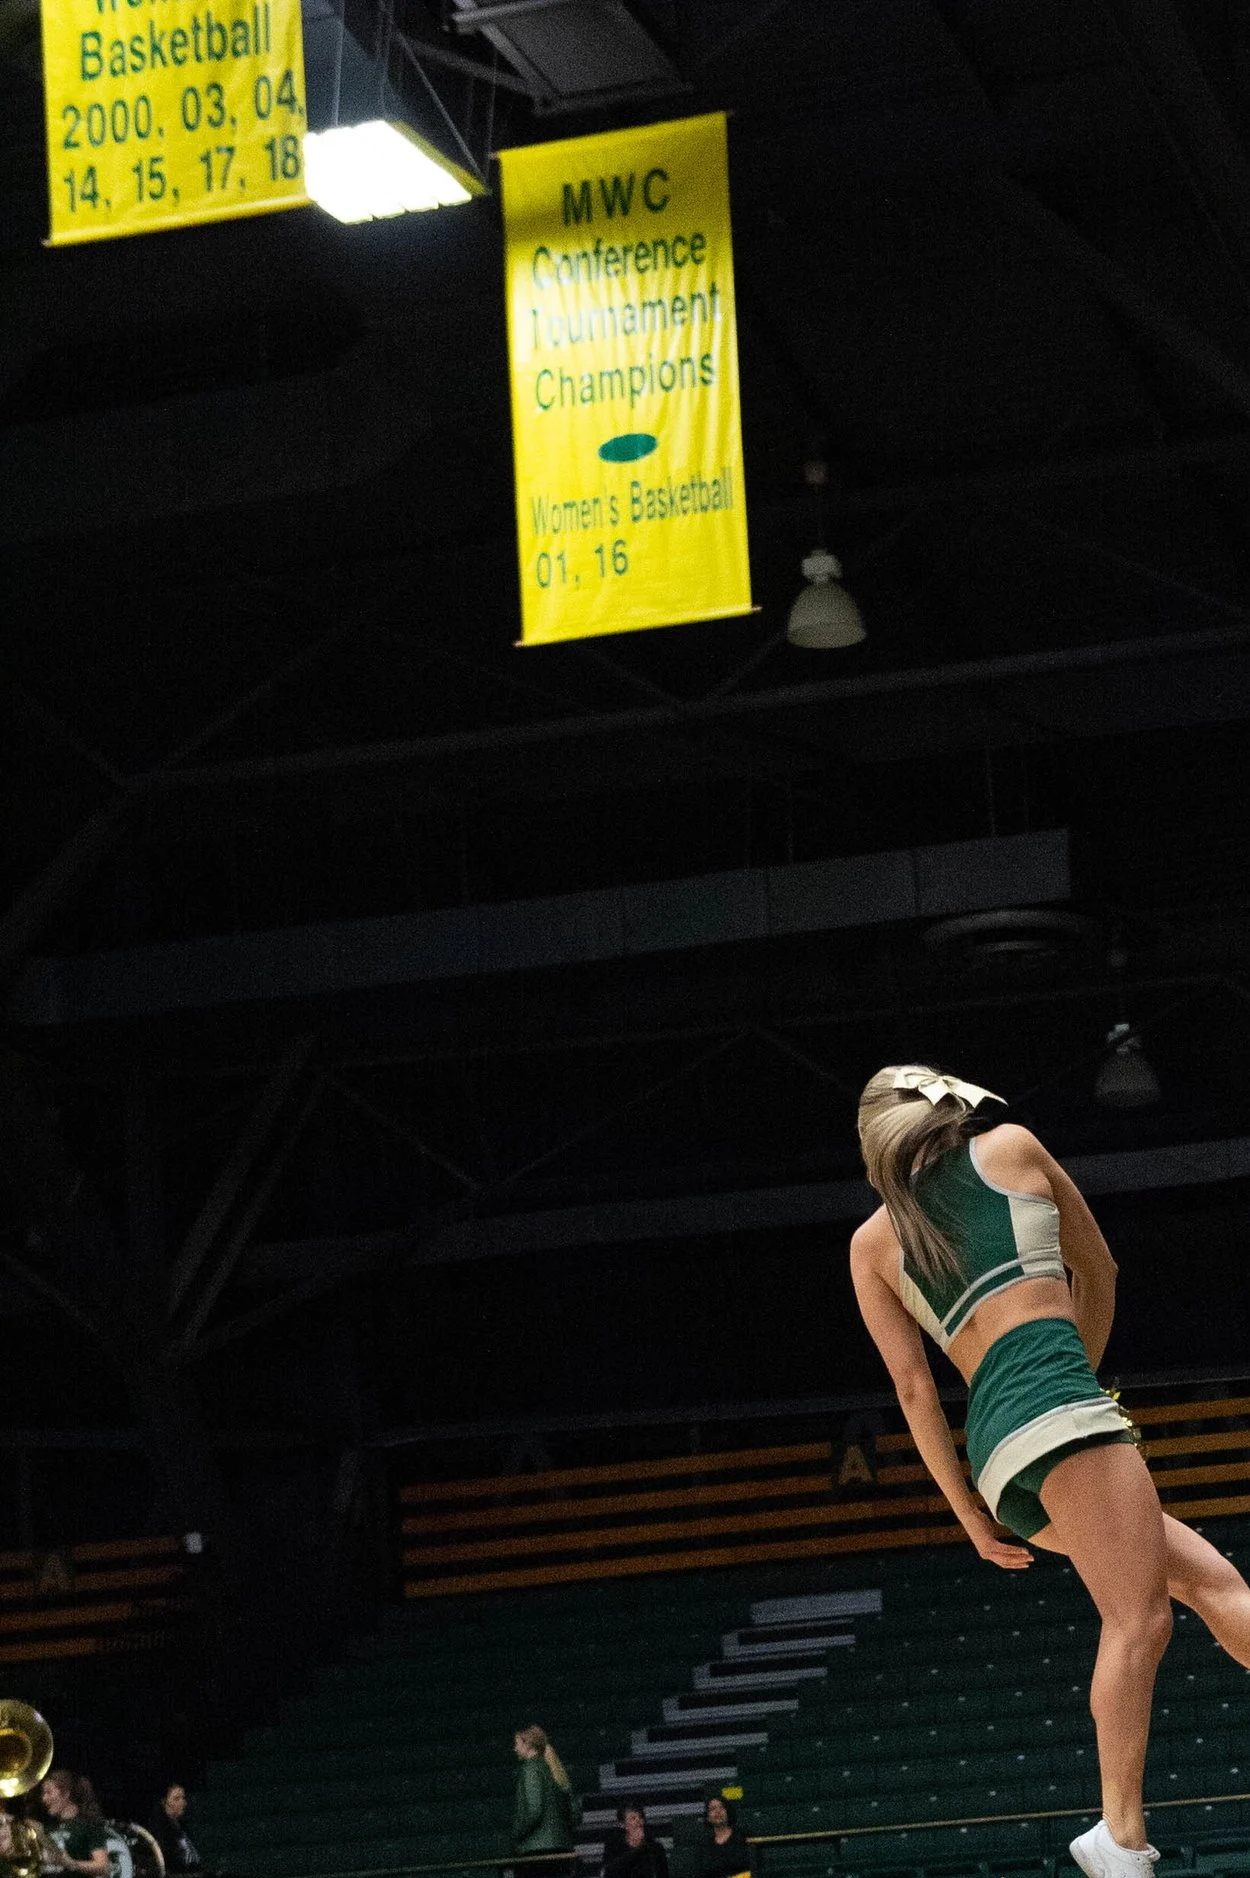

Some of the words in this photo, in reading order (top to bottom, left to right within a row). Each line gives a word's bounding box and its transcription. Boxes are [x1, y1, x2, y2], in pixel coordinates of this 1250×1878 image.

[80, 2, 271, 82] Basketball
[61, 93, 165, 150] 2000,
[181, 82, 238, 135] 03,
[63, 165, 113, 214] 14,
[132, 155, 182, 206] 15,
[199, 145, 247, 193] 17,
[264, 134, 302, 182] 18
[562, 166, 672, 228] MWC
[531, 231, 707, 290] Conference
[528, 279, 722, 351] Tournament
[534, 351, 716, 411] Champions
[530, 486, 619, 536] Women's
[629, 466, 734, 523] Basketball
[535, 550, 580, 590] 01,
[594, 538, 630, 579] 16
